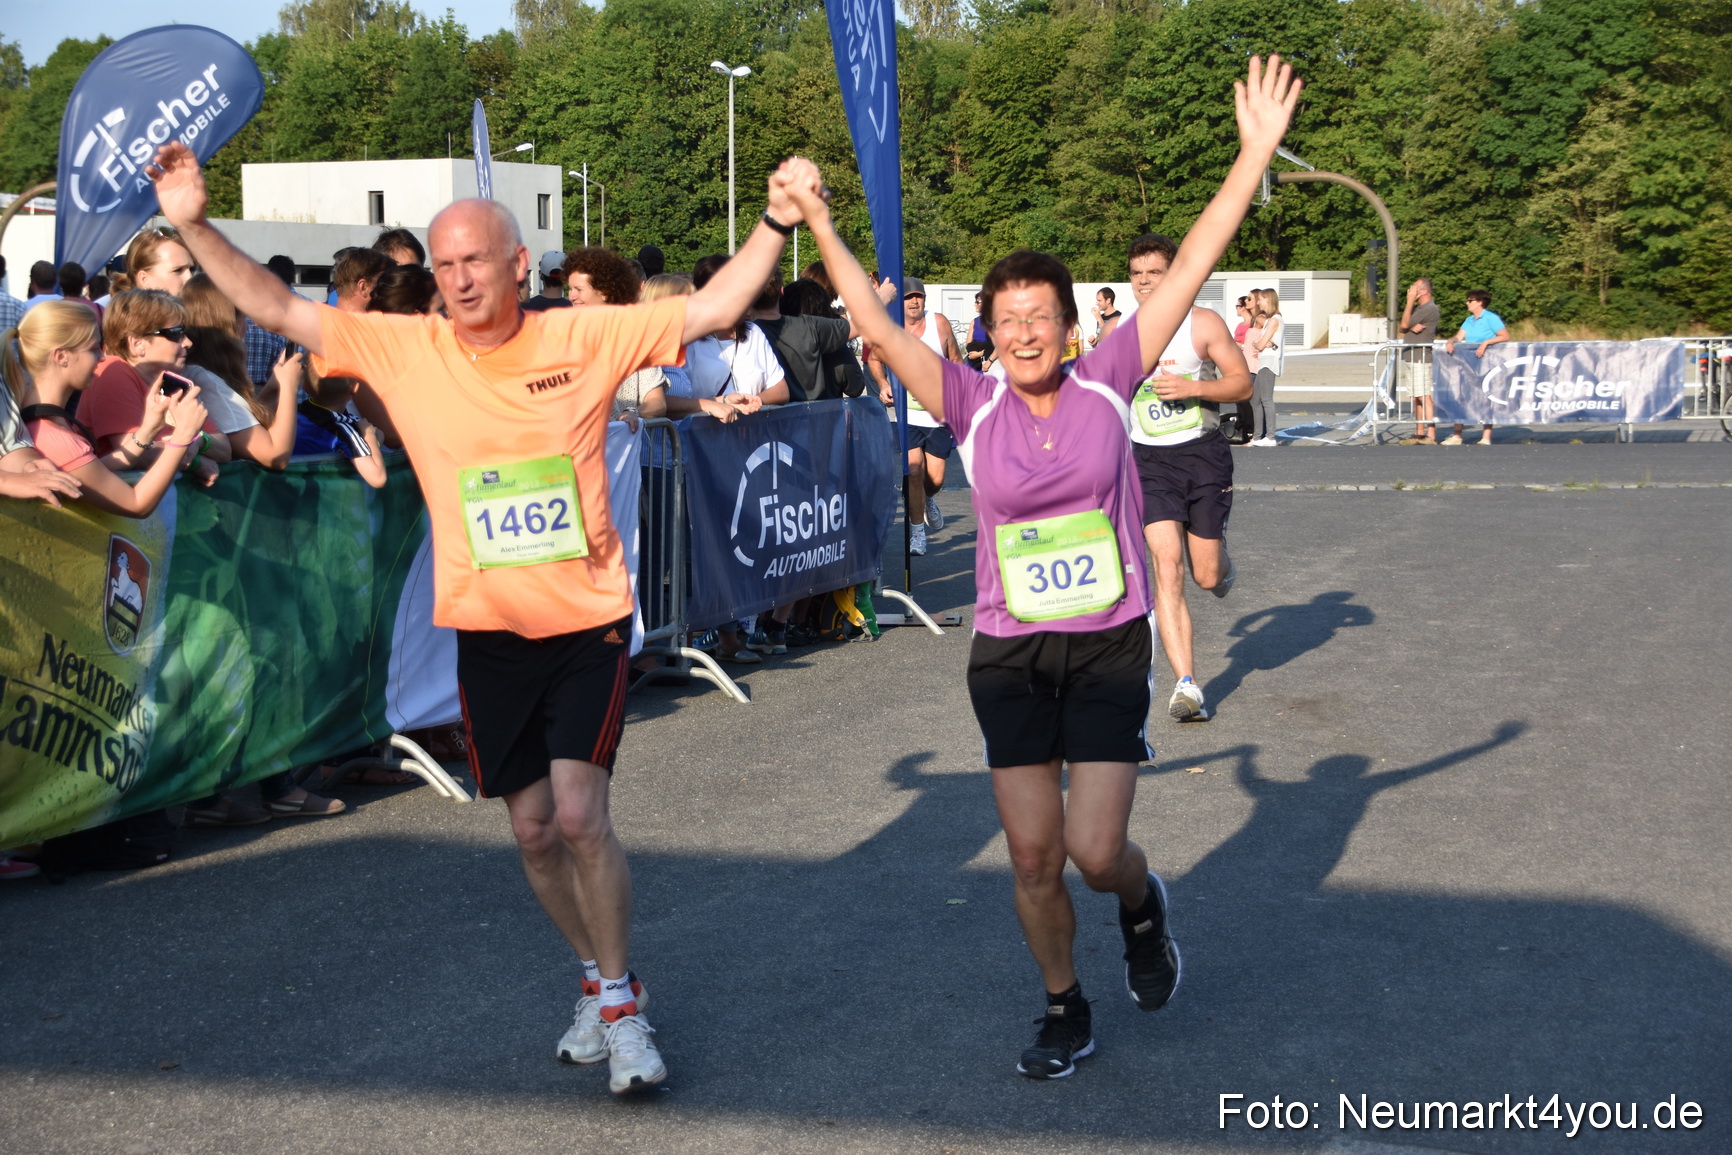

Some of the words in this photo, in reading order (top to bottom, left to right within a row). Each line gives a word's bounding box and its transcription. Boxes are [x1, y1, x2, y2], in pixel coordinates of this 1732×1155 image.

[99, 63, 220, 192] Fischer
[135, 93, 231, 193] AMOBILE
[526, 371, 572, 394] THULE
[1508, 375, 1631, 399] Fischer
[1148, 400, 1186, 421] 605
[1519, 401, 1620, 411] AUTOMOBILE
[476, 498, 571, 540] 1462
[763, 539, 846, 579] AUTOMOBILE
[1026, 554, 1097, 593] 302
[111, 624, 131, 647] 1628
